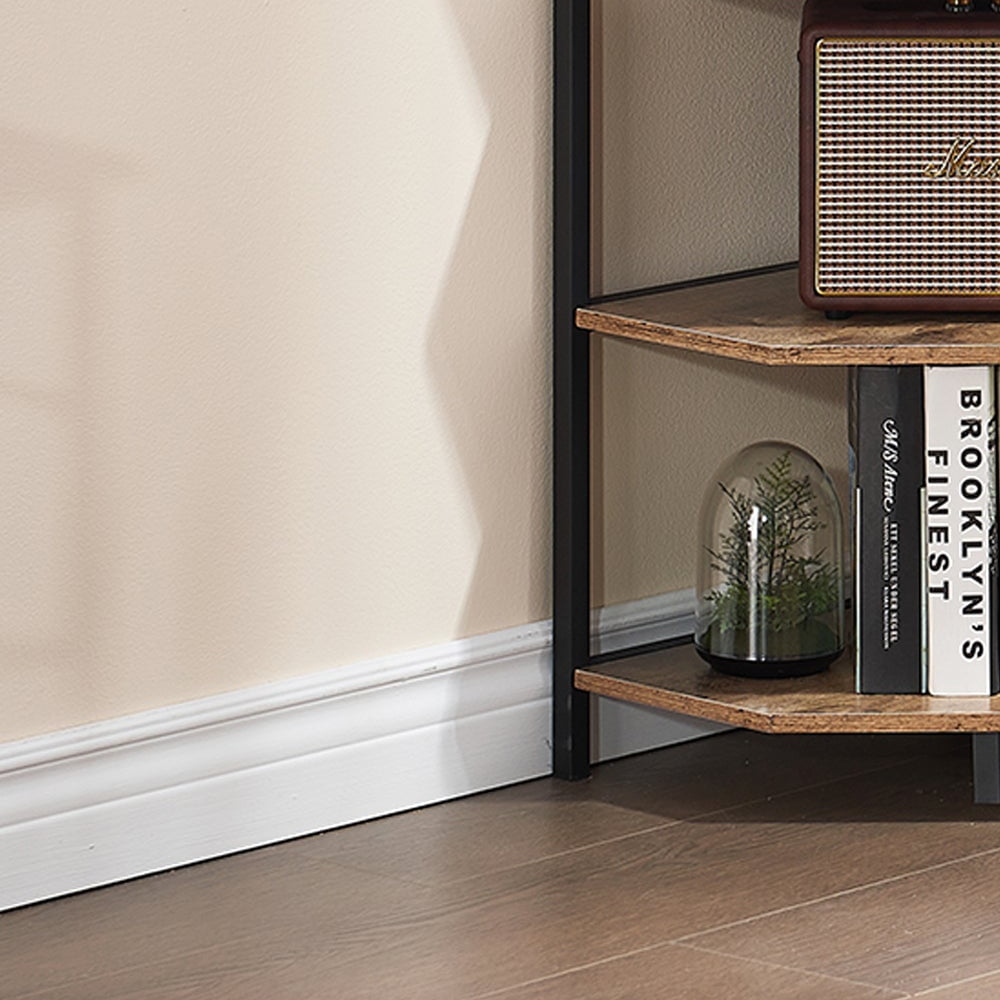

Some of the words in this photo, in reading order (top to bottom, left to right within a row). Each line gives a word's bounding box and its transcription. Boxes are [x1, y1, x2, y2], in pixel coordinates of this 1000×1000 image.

[882, 419, 898, 462] M/S
[927, 449, 949, 600] FINEST
[960, 389, 984, 659] BROOKLYN'S
